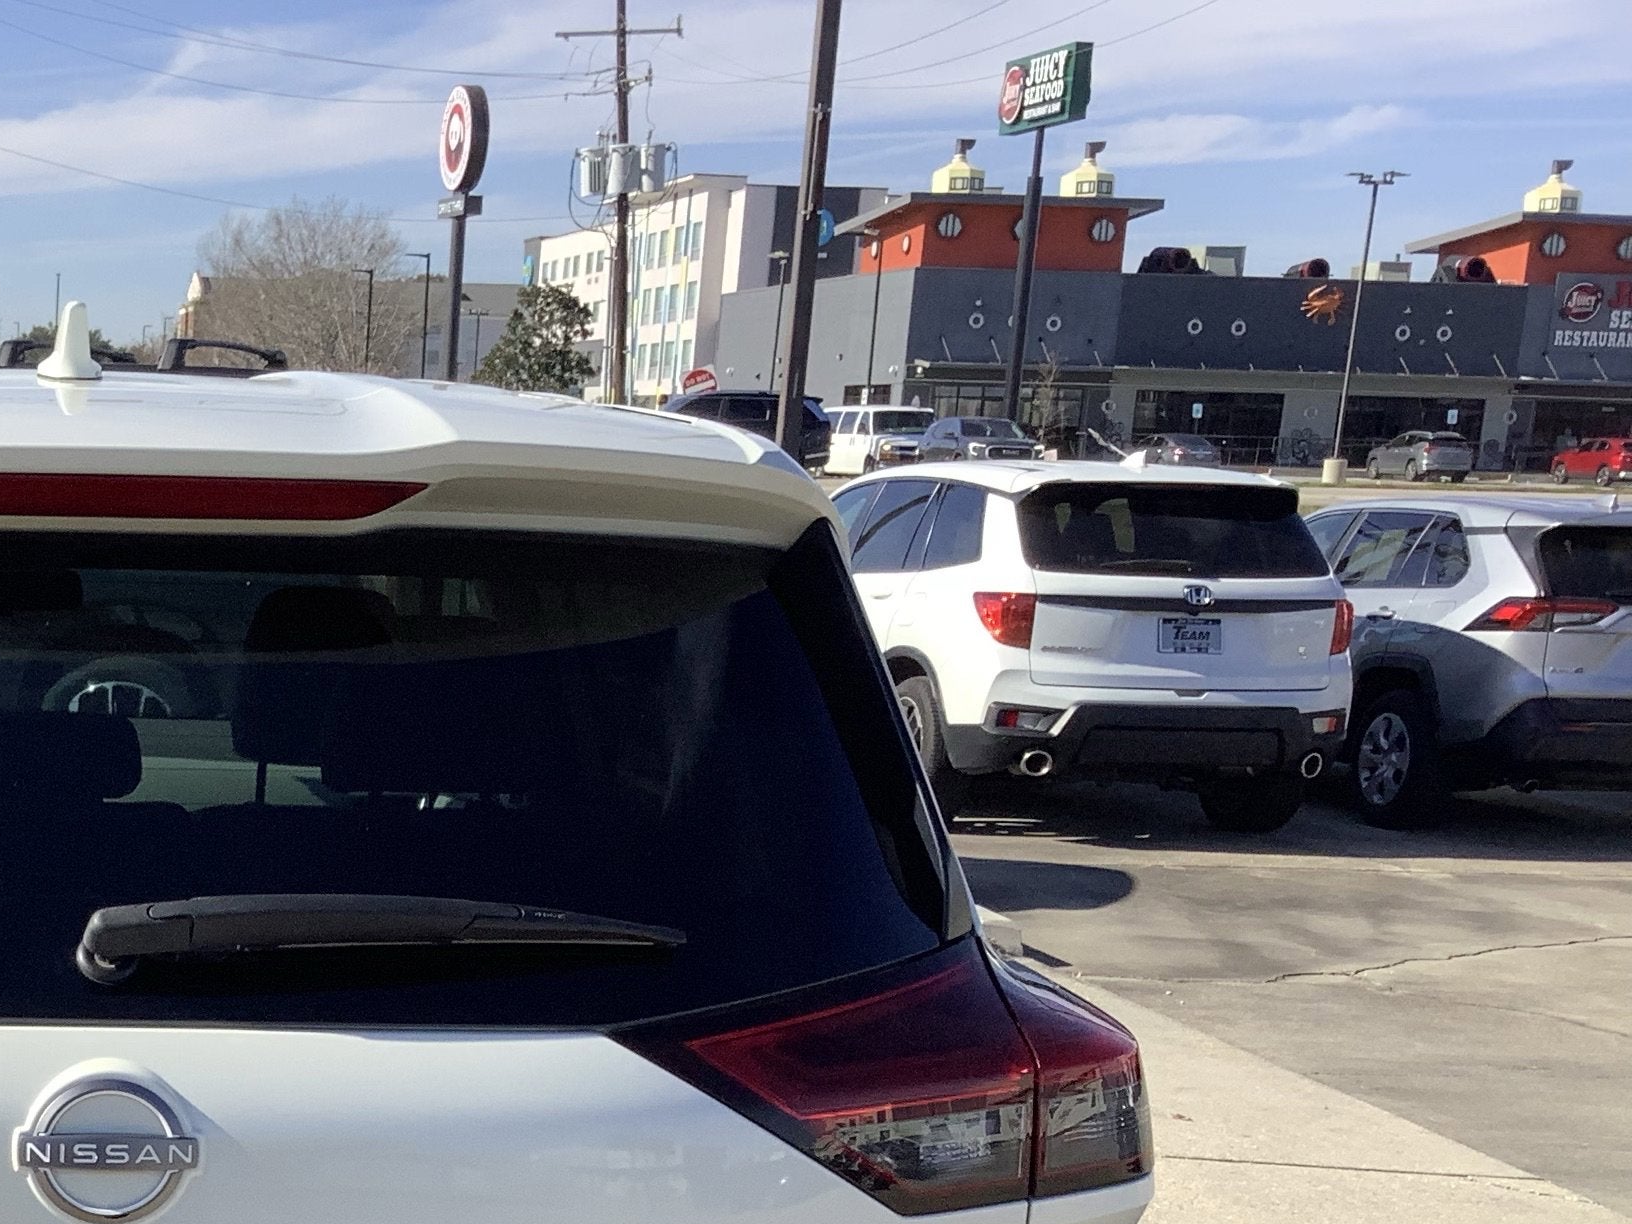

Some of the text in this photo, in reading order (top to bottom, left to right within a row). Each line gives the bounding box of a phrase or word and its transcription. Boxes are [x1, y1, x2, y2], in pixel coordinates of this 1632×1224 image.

[1025, 50, 1068, 86] JUICY
[1024, 79, 1064, 106] SEAFOOD
[1173, 626, 1210, 641] TEAM
[25, 1142, 193, 1164] NISSAN
